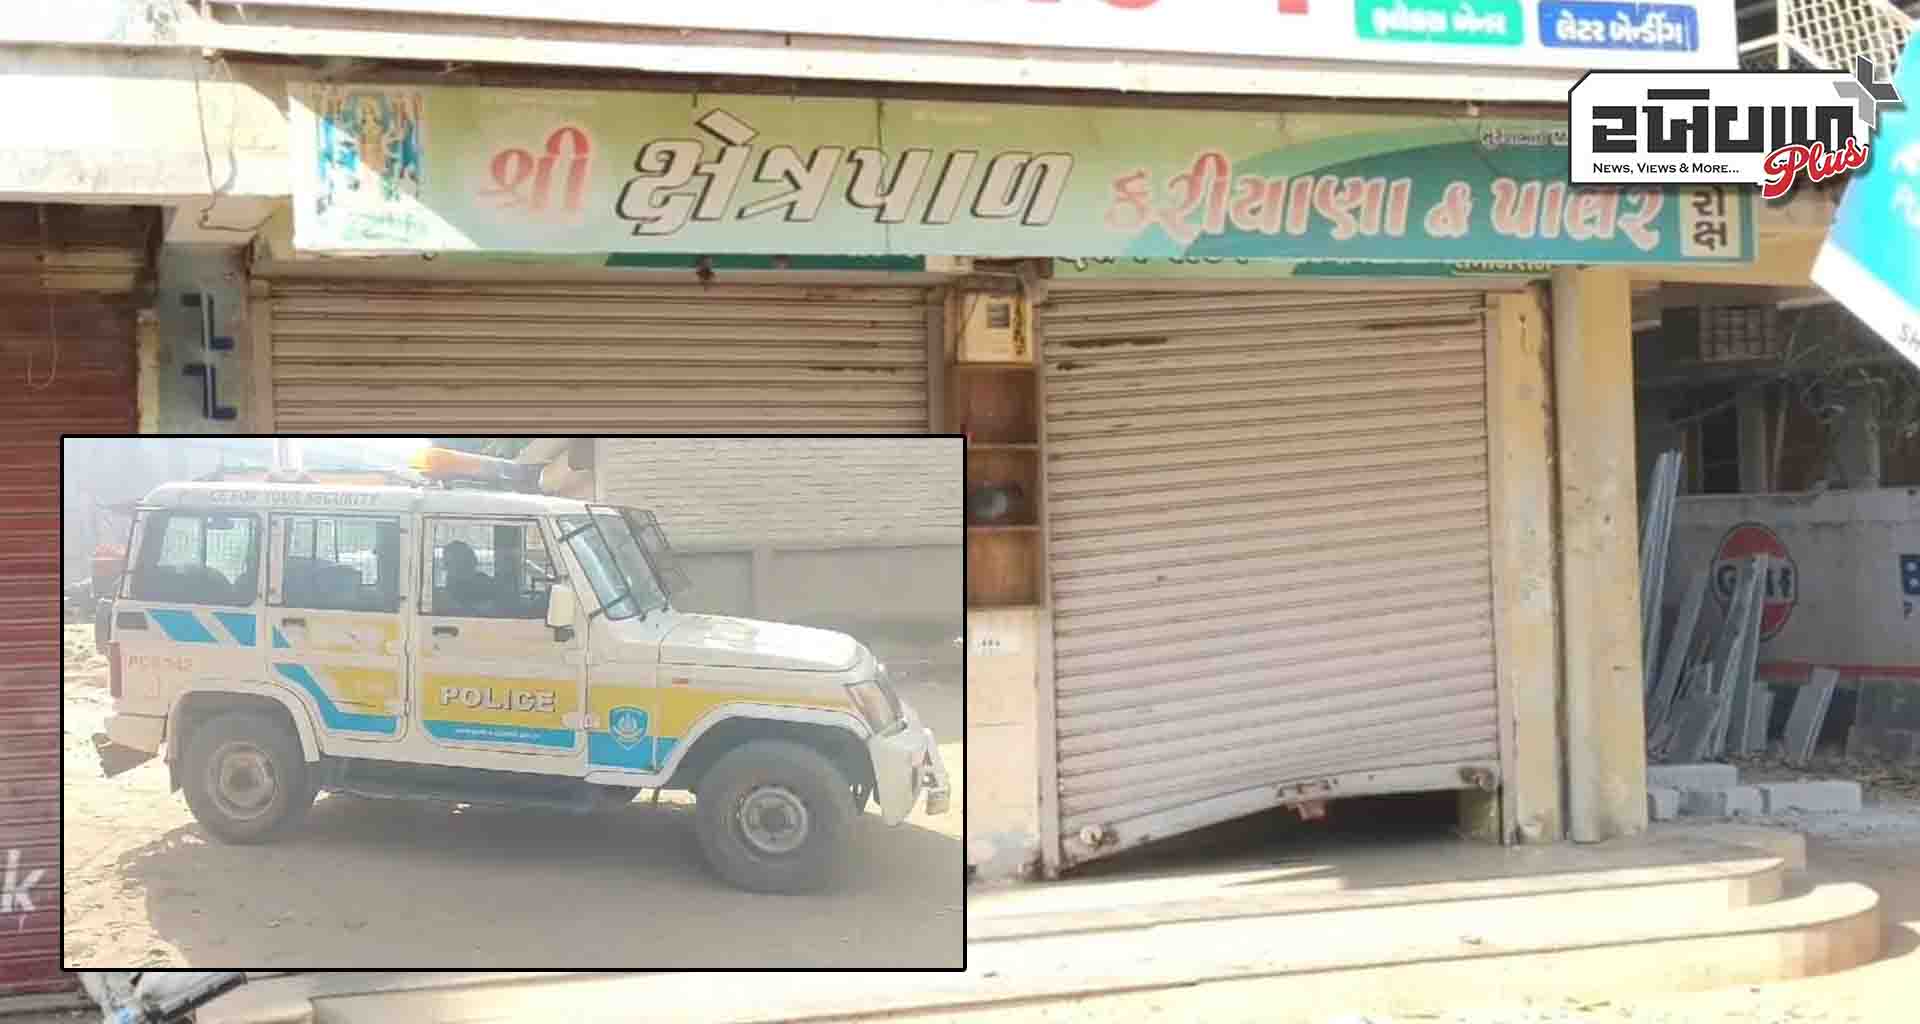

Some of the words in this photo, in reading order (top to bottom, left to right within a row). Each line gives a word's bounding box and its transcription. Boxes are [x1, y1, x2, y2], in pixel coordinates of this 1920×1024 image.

[474, 124, 592, 219] શ્રી
[614, 107, 1073, 236] ક્ષેત્રપાળ
[1425, 181, 1472, 239] &
[440, 687, 557, 712] POLICE
